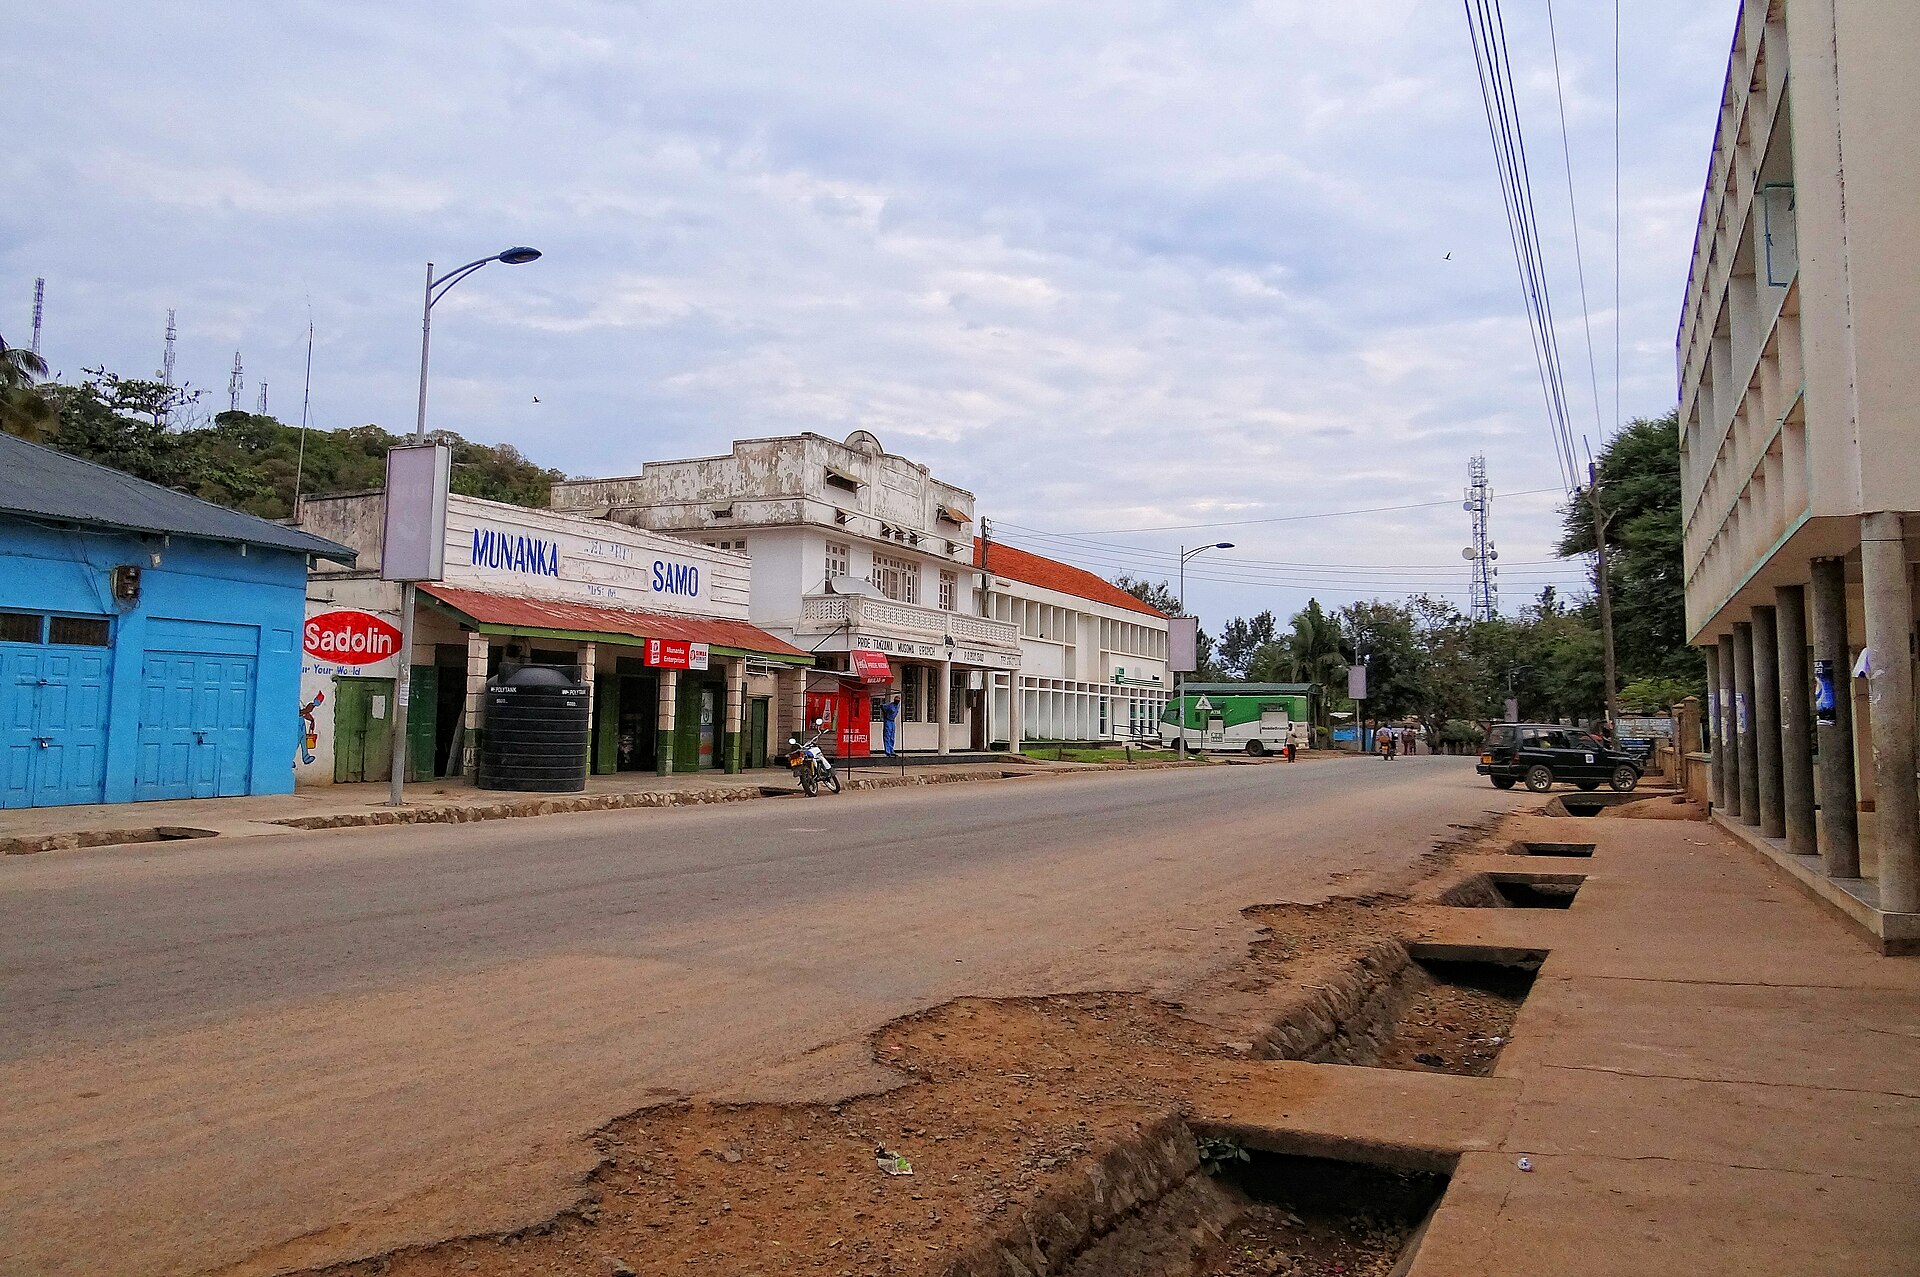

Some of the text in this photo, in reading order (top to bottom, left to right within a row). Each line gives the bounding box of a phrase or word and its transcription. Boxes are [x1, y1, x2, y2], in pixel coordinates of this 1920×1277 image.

[472, 528, 559, 578] MUNANKA
[652, 560, 699, 597] SAMO
[304, 622, 392, 654] Sadolin
[857, 636, 871, 650] PRIDE
[897, 643, 915, 655] MUSOMA
[666, 646, 685, 655] Munanka
[663, 655, 686, 664] Enterprises
[313, 664, 333, 675] Your
[337, 665, 361, 676] Wold
